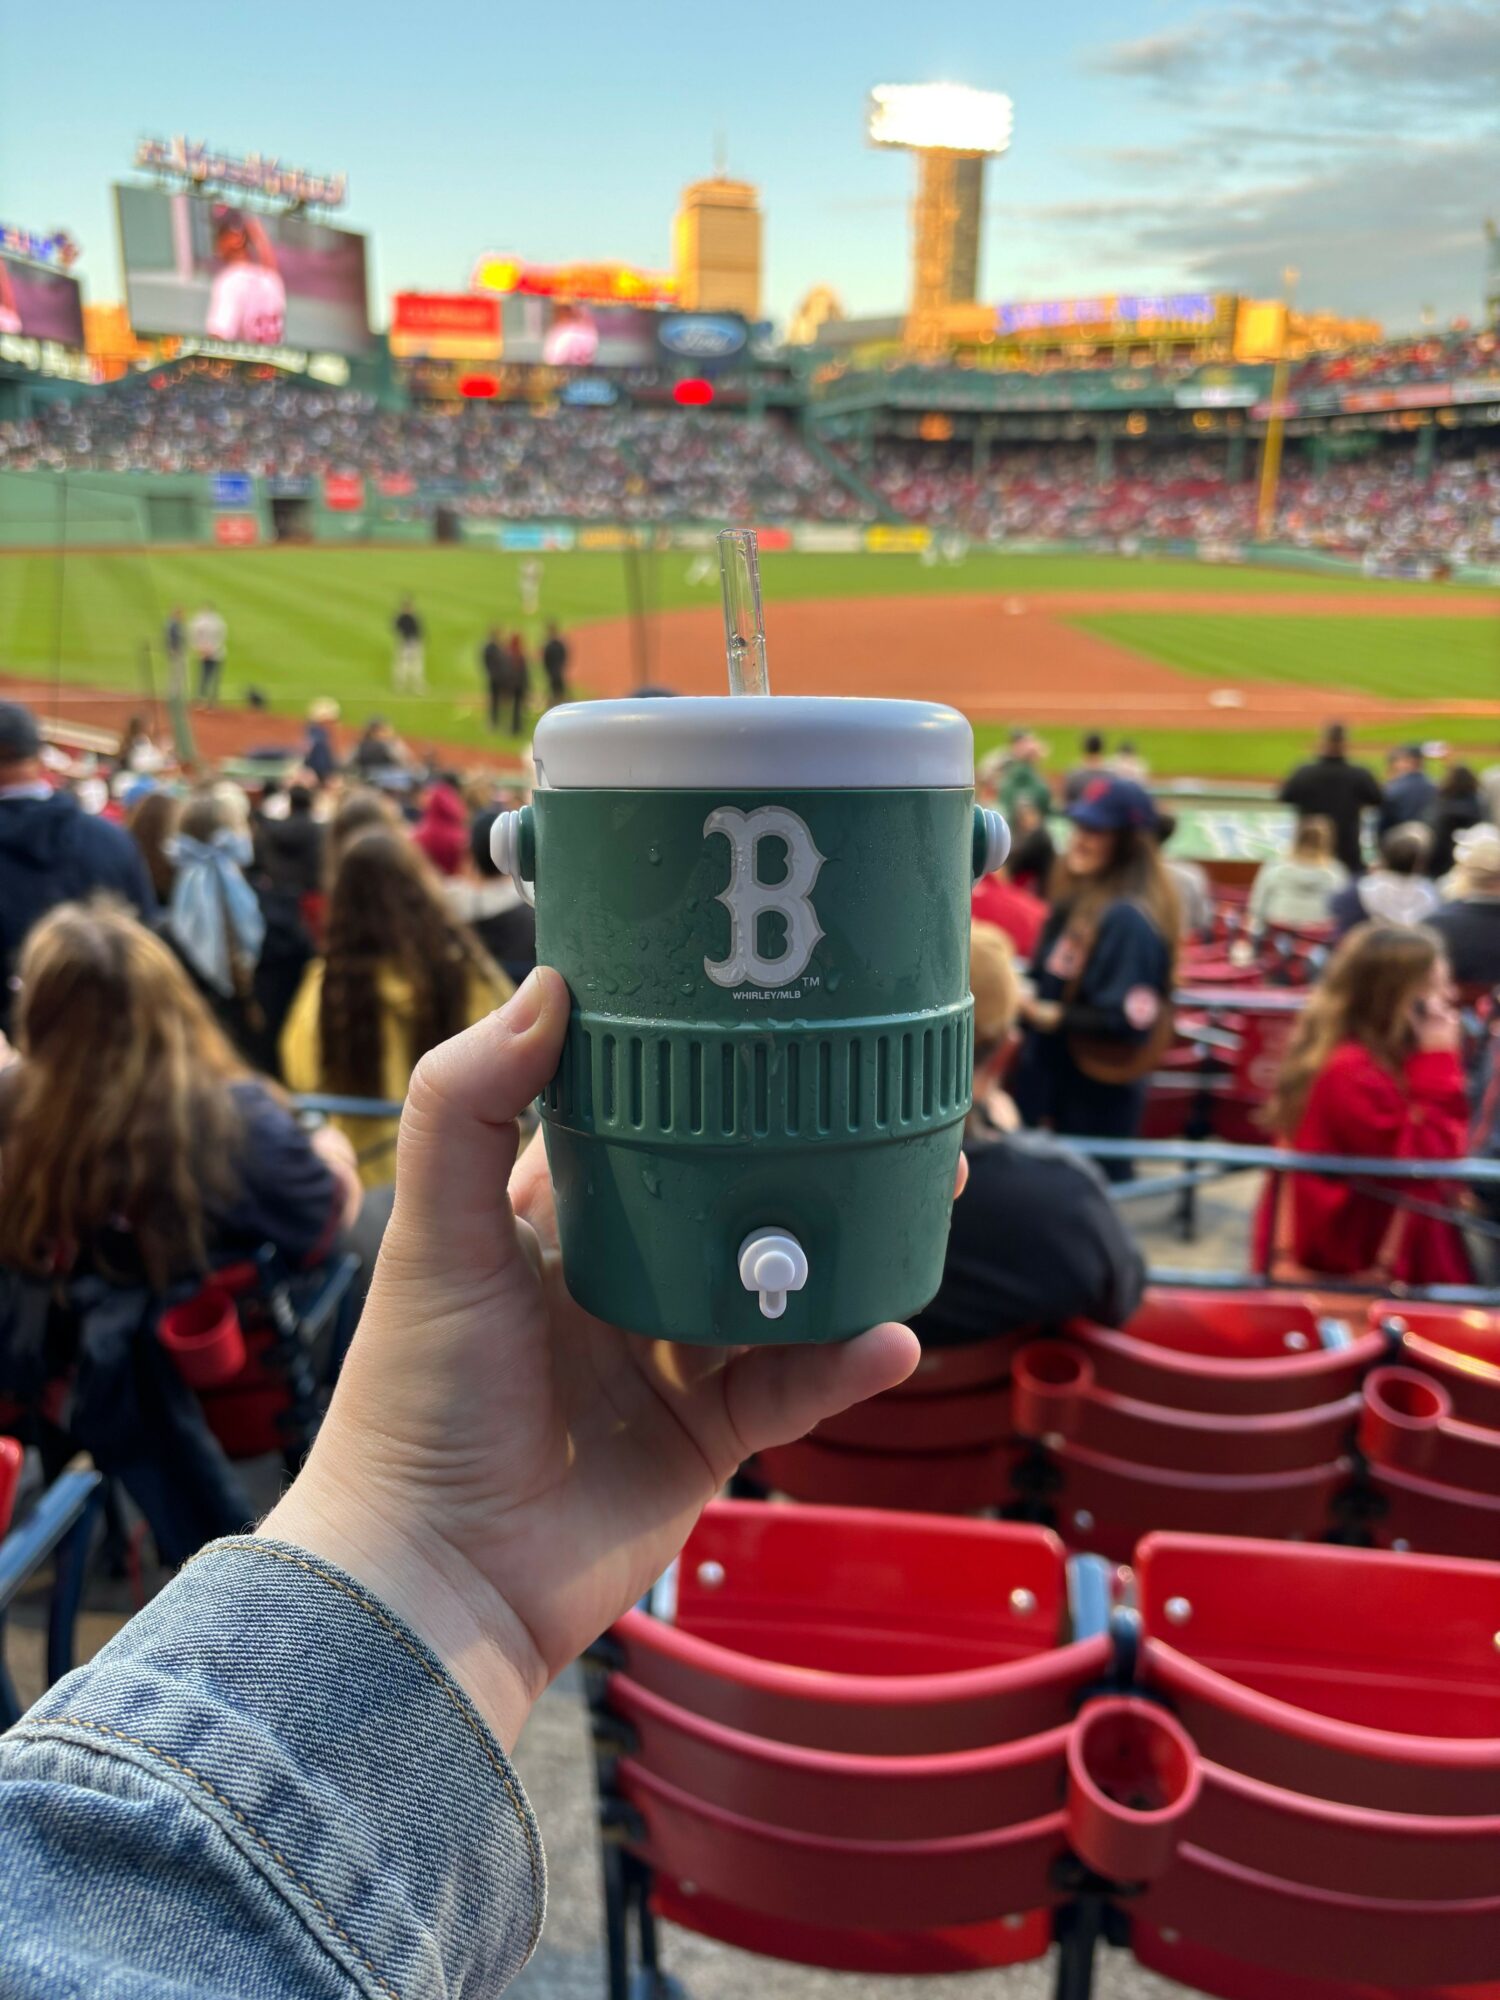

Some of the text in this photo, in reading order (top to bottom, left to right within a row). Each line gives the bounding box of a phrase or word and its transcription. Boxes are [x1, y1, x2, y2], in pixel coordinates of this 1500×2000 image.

[703, 805, 828, 988] B
[801, 976, 820, 987] TM
[732, 990, 801, 1000] WHIRLEY/MLB
